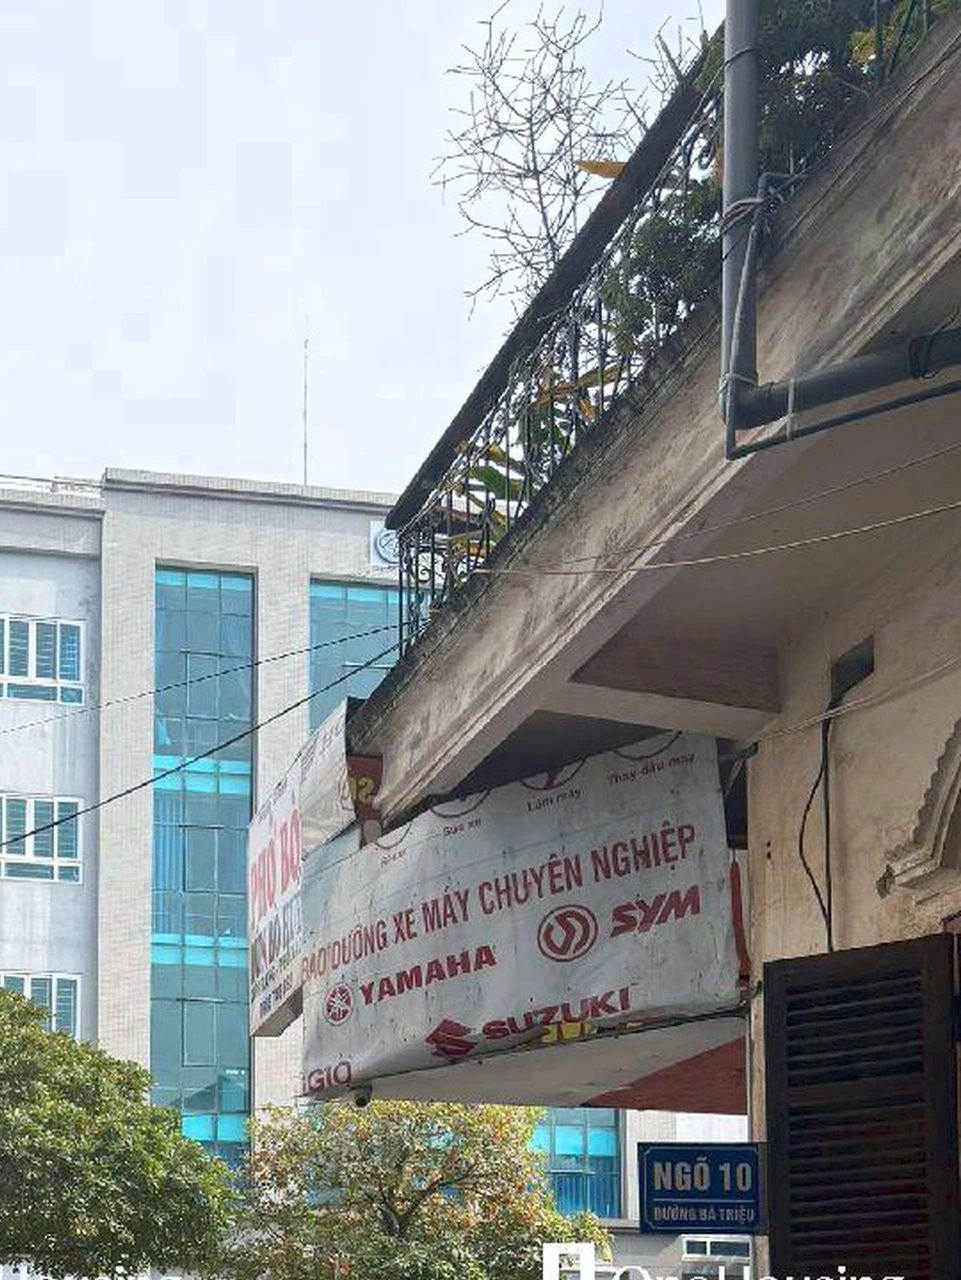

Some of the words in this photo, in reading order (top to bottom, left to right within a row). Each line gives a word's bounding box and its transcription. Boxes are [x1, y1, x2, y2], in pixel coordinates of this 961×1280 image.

[393, 908, 418, 945] XE
[422, 887, 470, 934] MÁY
[478, 853, 583, 915] CHUYÊN
[591, 819, 696, 883] NGHIỆP
[610, 884, 701, 938] SYM
[360, 945, 496, 1006] YAMAHA
[482, 985, 631, 1041] SUZUKI
[653, 1156, 710, 1191] NGÕ
[719, 1162, 752, 1192] 10
[718, 1206, 754, 1224] TRIỆU
